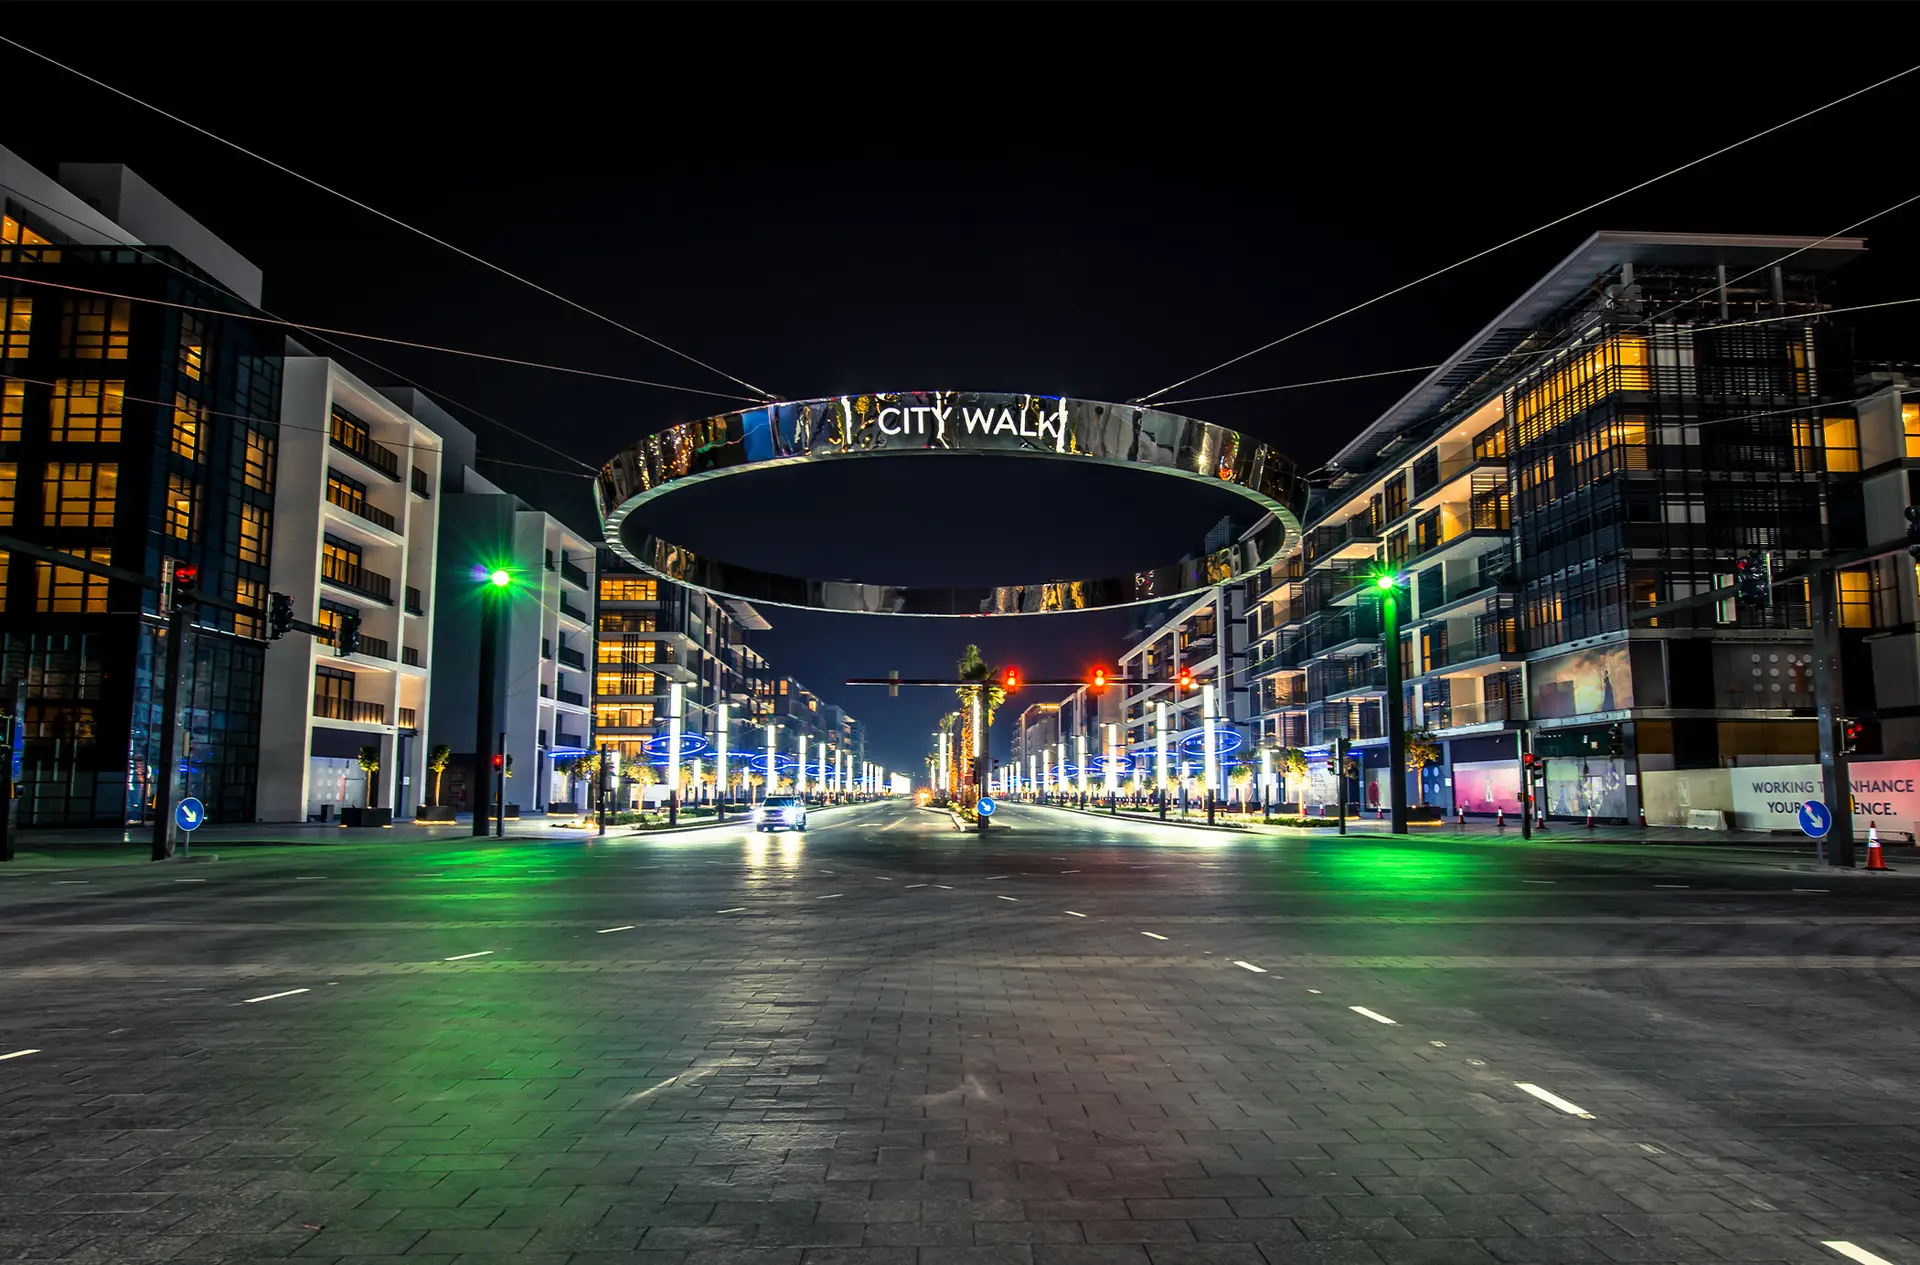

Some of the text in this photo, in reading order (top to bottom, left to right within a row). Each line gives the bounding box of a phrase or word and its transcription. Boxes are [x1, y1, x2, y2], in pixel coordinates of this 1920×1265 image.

[878, 407, 1058, 438] CITY WALK
[1752, 781, 1814, 794] WORKING
[1850, 779, 1914, 793] NHANCE
[1767, 801, 1801, 814] YOUR
